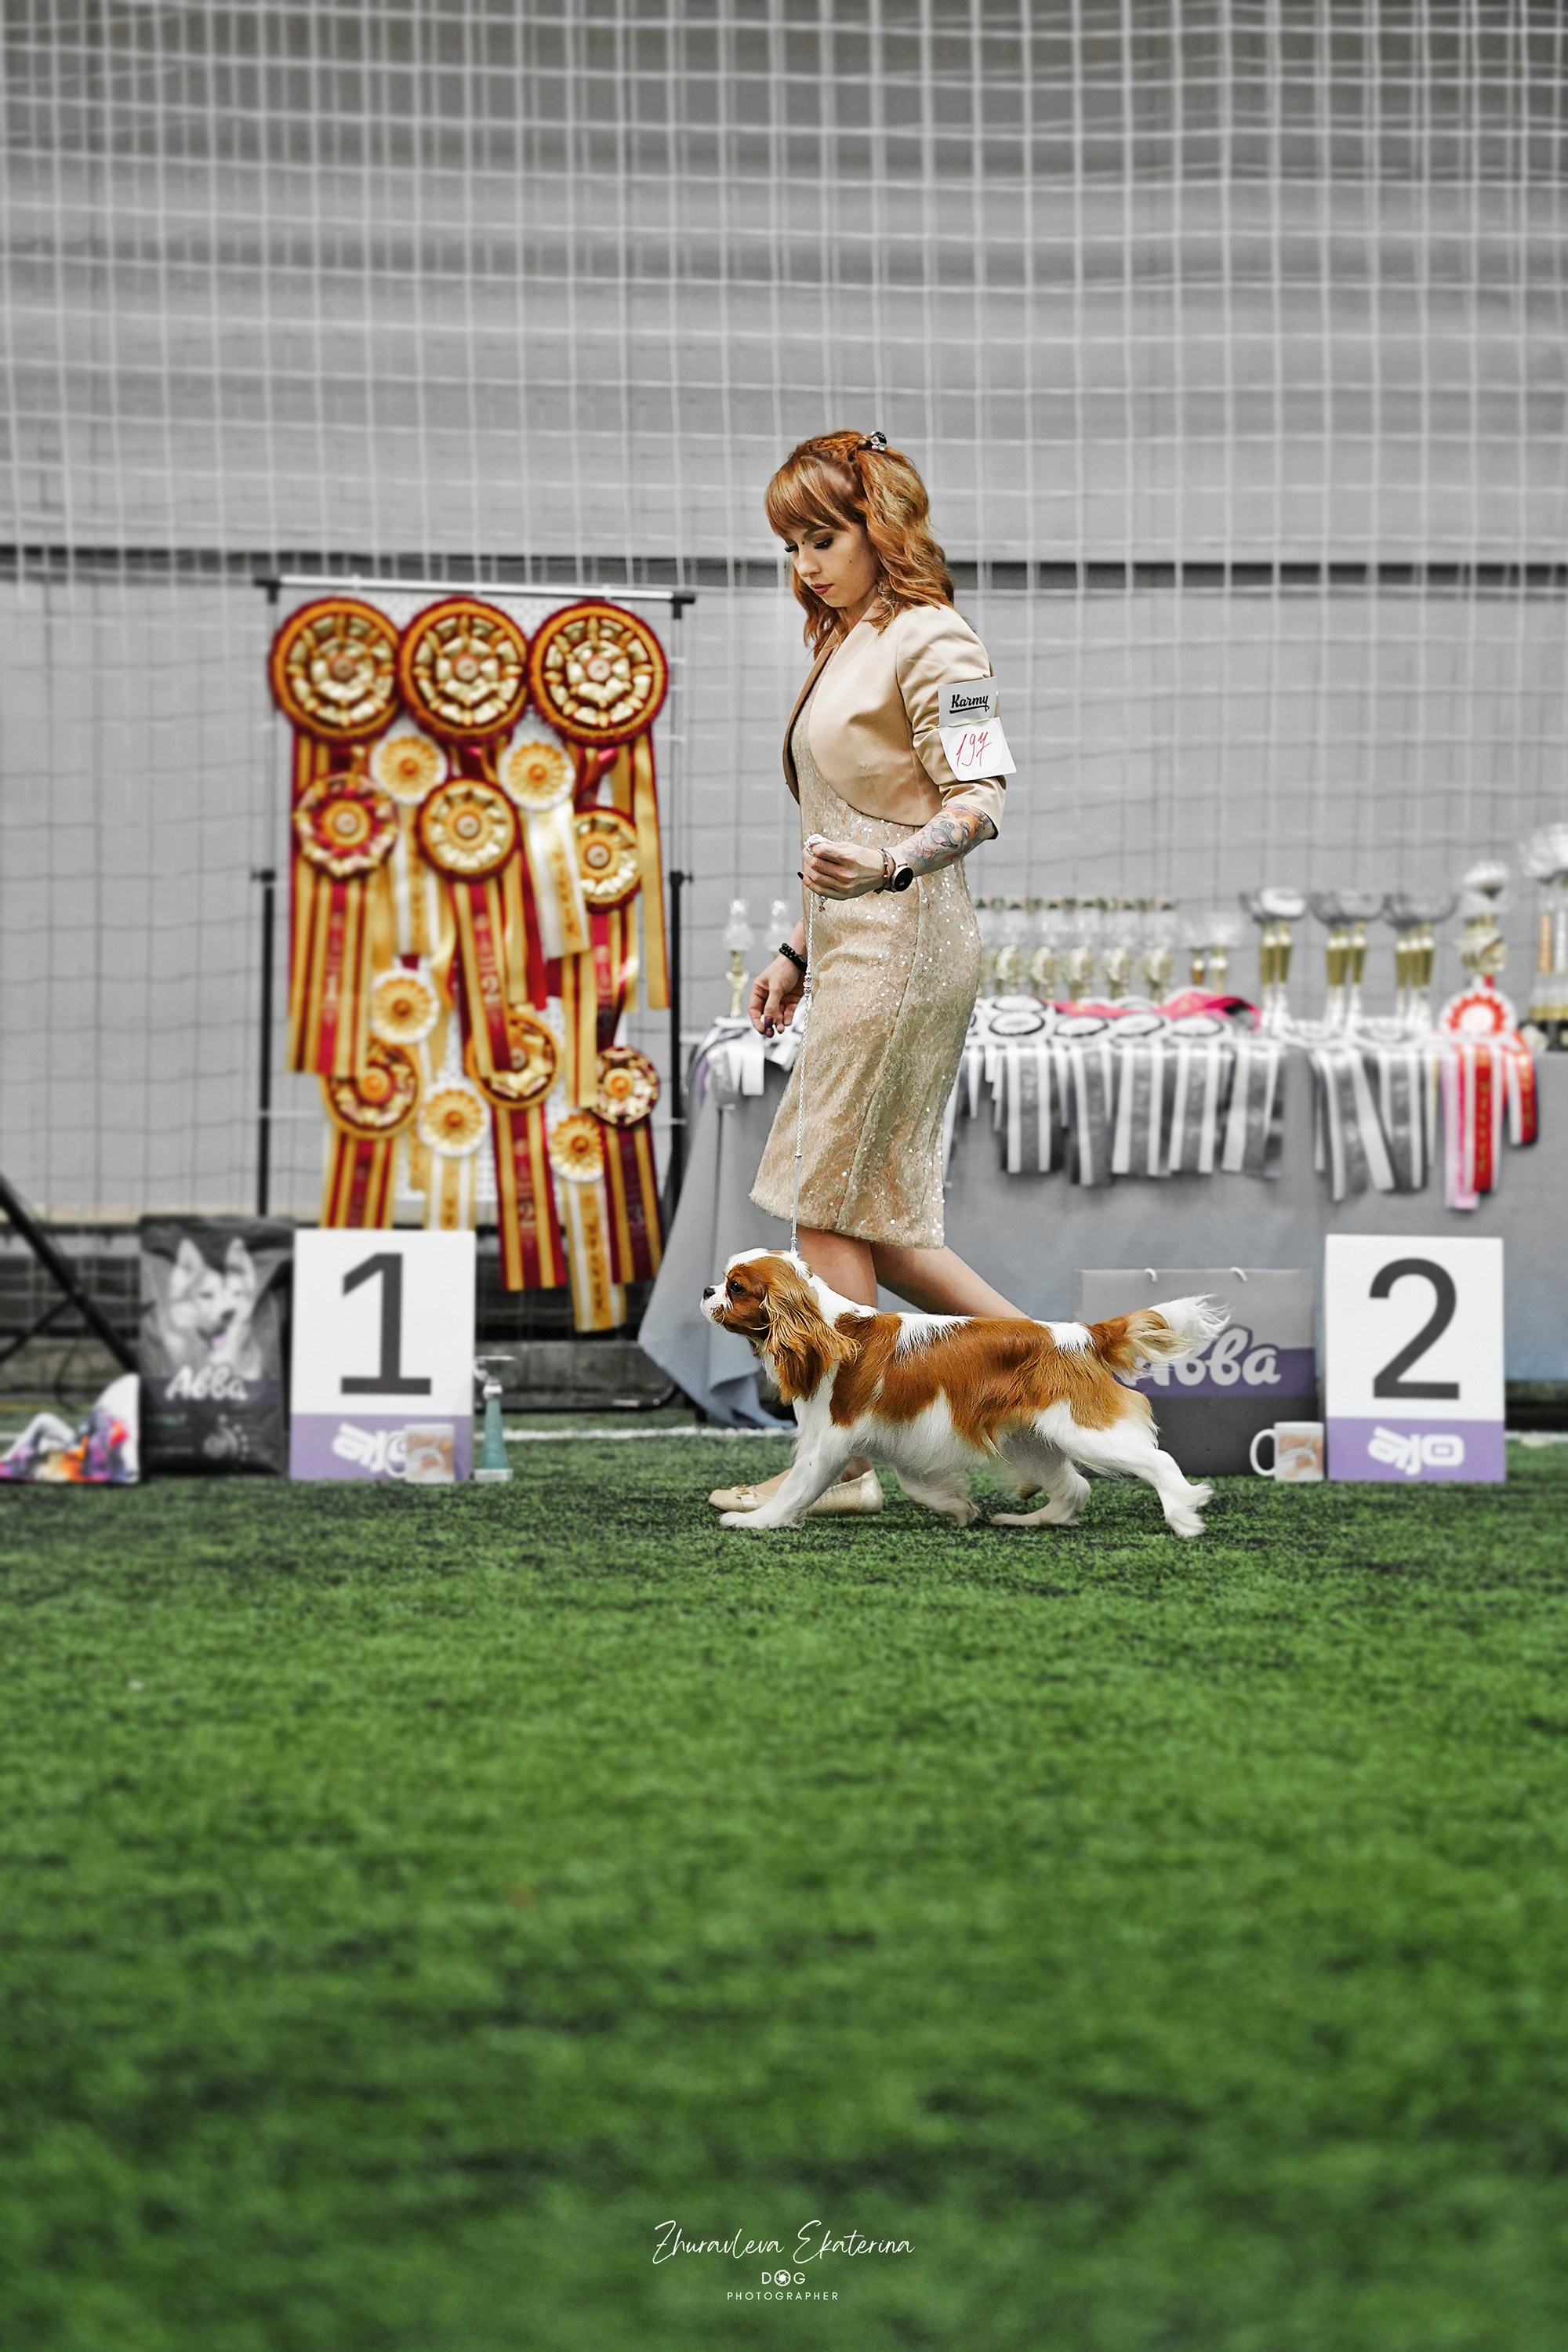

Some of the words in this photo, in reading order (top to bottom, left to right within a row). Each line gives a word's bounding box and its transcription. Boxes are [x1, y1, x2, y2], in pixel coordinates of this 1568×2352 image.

[949, 694, 990, 713] Karmy
[340, 1252, 431, 1395] 1
[1369, 1258, 1460, 1399] 2
